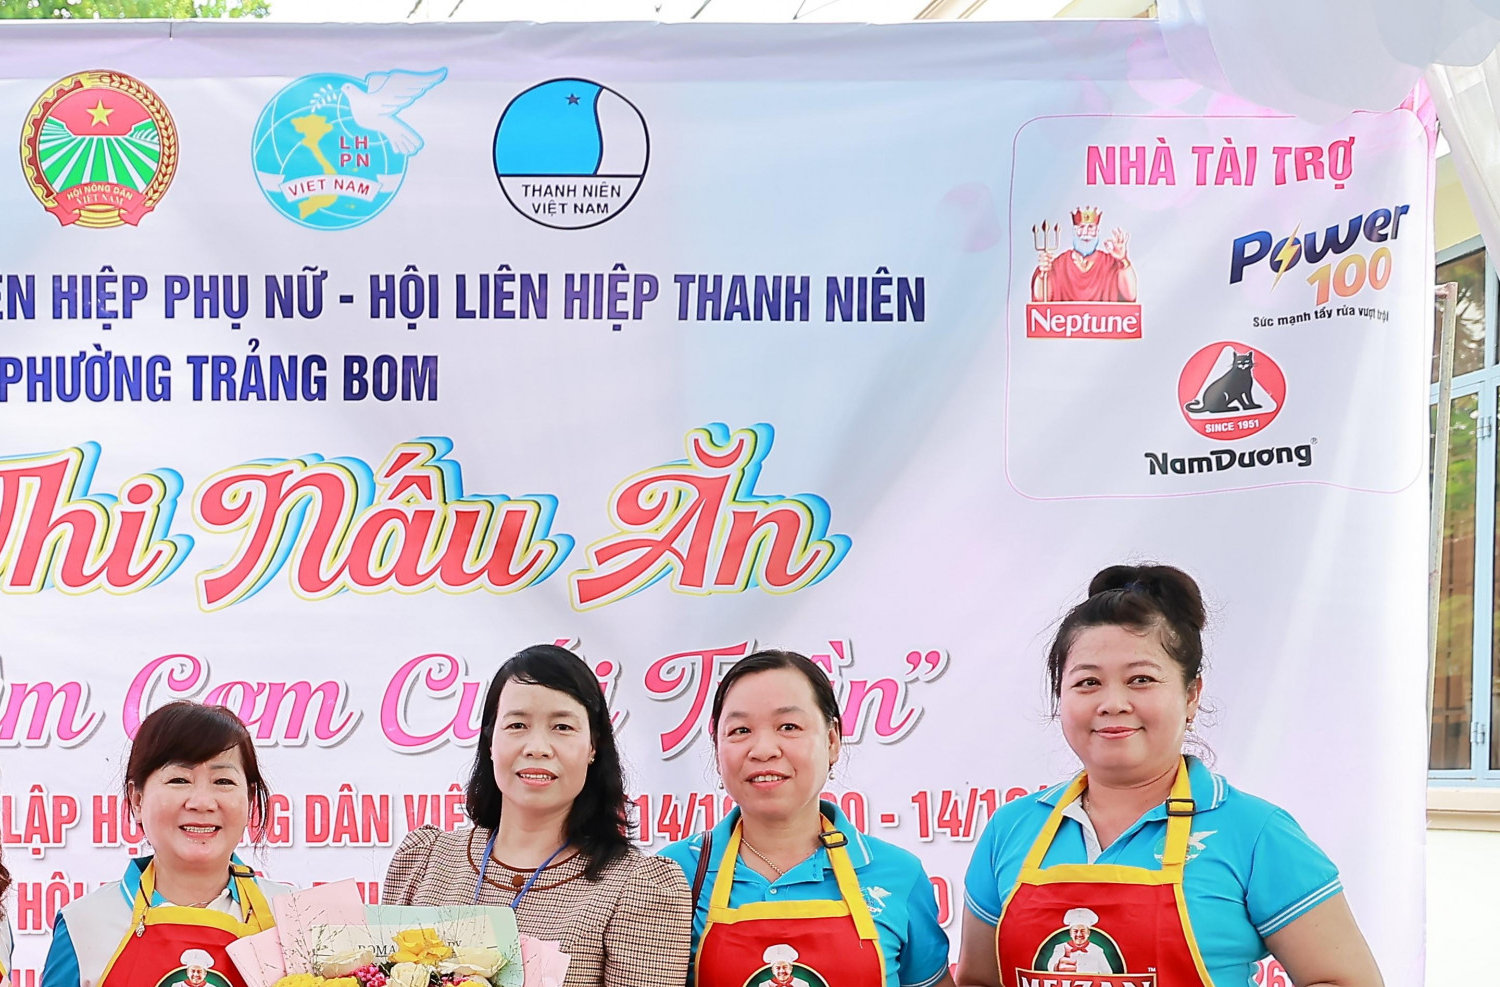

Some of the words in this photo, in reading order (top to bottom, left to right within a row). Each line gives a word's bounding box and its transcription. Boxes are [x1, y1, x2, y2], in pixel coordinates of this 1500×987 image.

[1086, 136, 1177, 187] NHÀ
[1192, 136, 1258, 187] TÀI
[1272, 136, 1356, 190] TRỢ
[84, 184, 111, 194] NÔNG
[334, 178, 370, 196] NAM
[522, 184, 577, 198] THANH
[583, 181, 621, 198] NIÊN
[532, 200, 568, 216] VIỆT
[574, 203, 609, 214] NAM
[1229, 204, 1411, 286] Power
[52, 265, 147, 331] HIỆP
[164, 273, 249, 331] PHỤ
[264, 265, 329, 320] NỮ
[369, 264, 439, 330] HỘI
[455, 264, 548, 320] LIÊN
[563, 263, 659, 332] HIỆP
[673, 273, 811, 322] THANH
[825, 266, 926, 323] NIÊN
[1306, 246, 1392, 307] 100
[1030, 308, 1138, 338] Neptune
[1253, 314, 1274, 328] Sức
[1277, 310, 1311, 328] mạnh
[1314, 306, 1334, 321] tẩy
[1336, 306, 1356, 317] rửa
[186, 337, 327, 402] TRẢNG
[343, 354, 439, 402] BOM
[1205, 421, 1235, 434] SINCE
[1237, 418, 1260, 431] 1951
[196, 444, 558, 609] Nấu
[572, 430, 836, 609] Ăn
[2, 784, 77, 855] LẬP
[305, 783, 390, 843] DÂN
